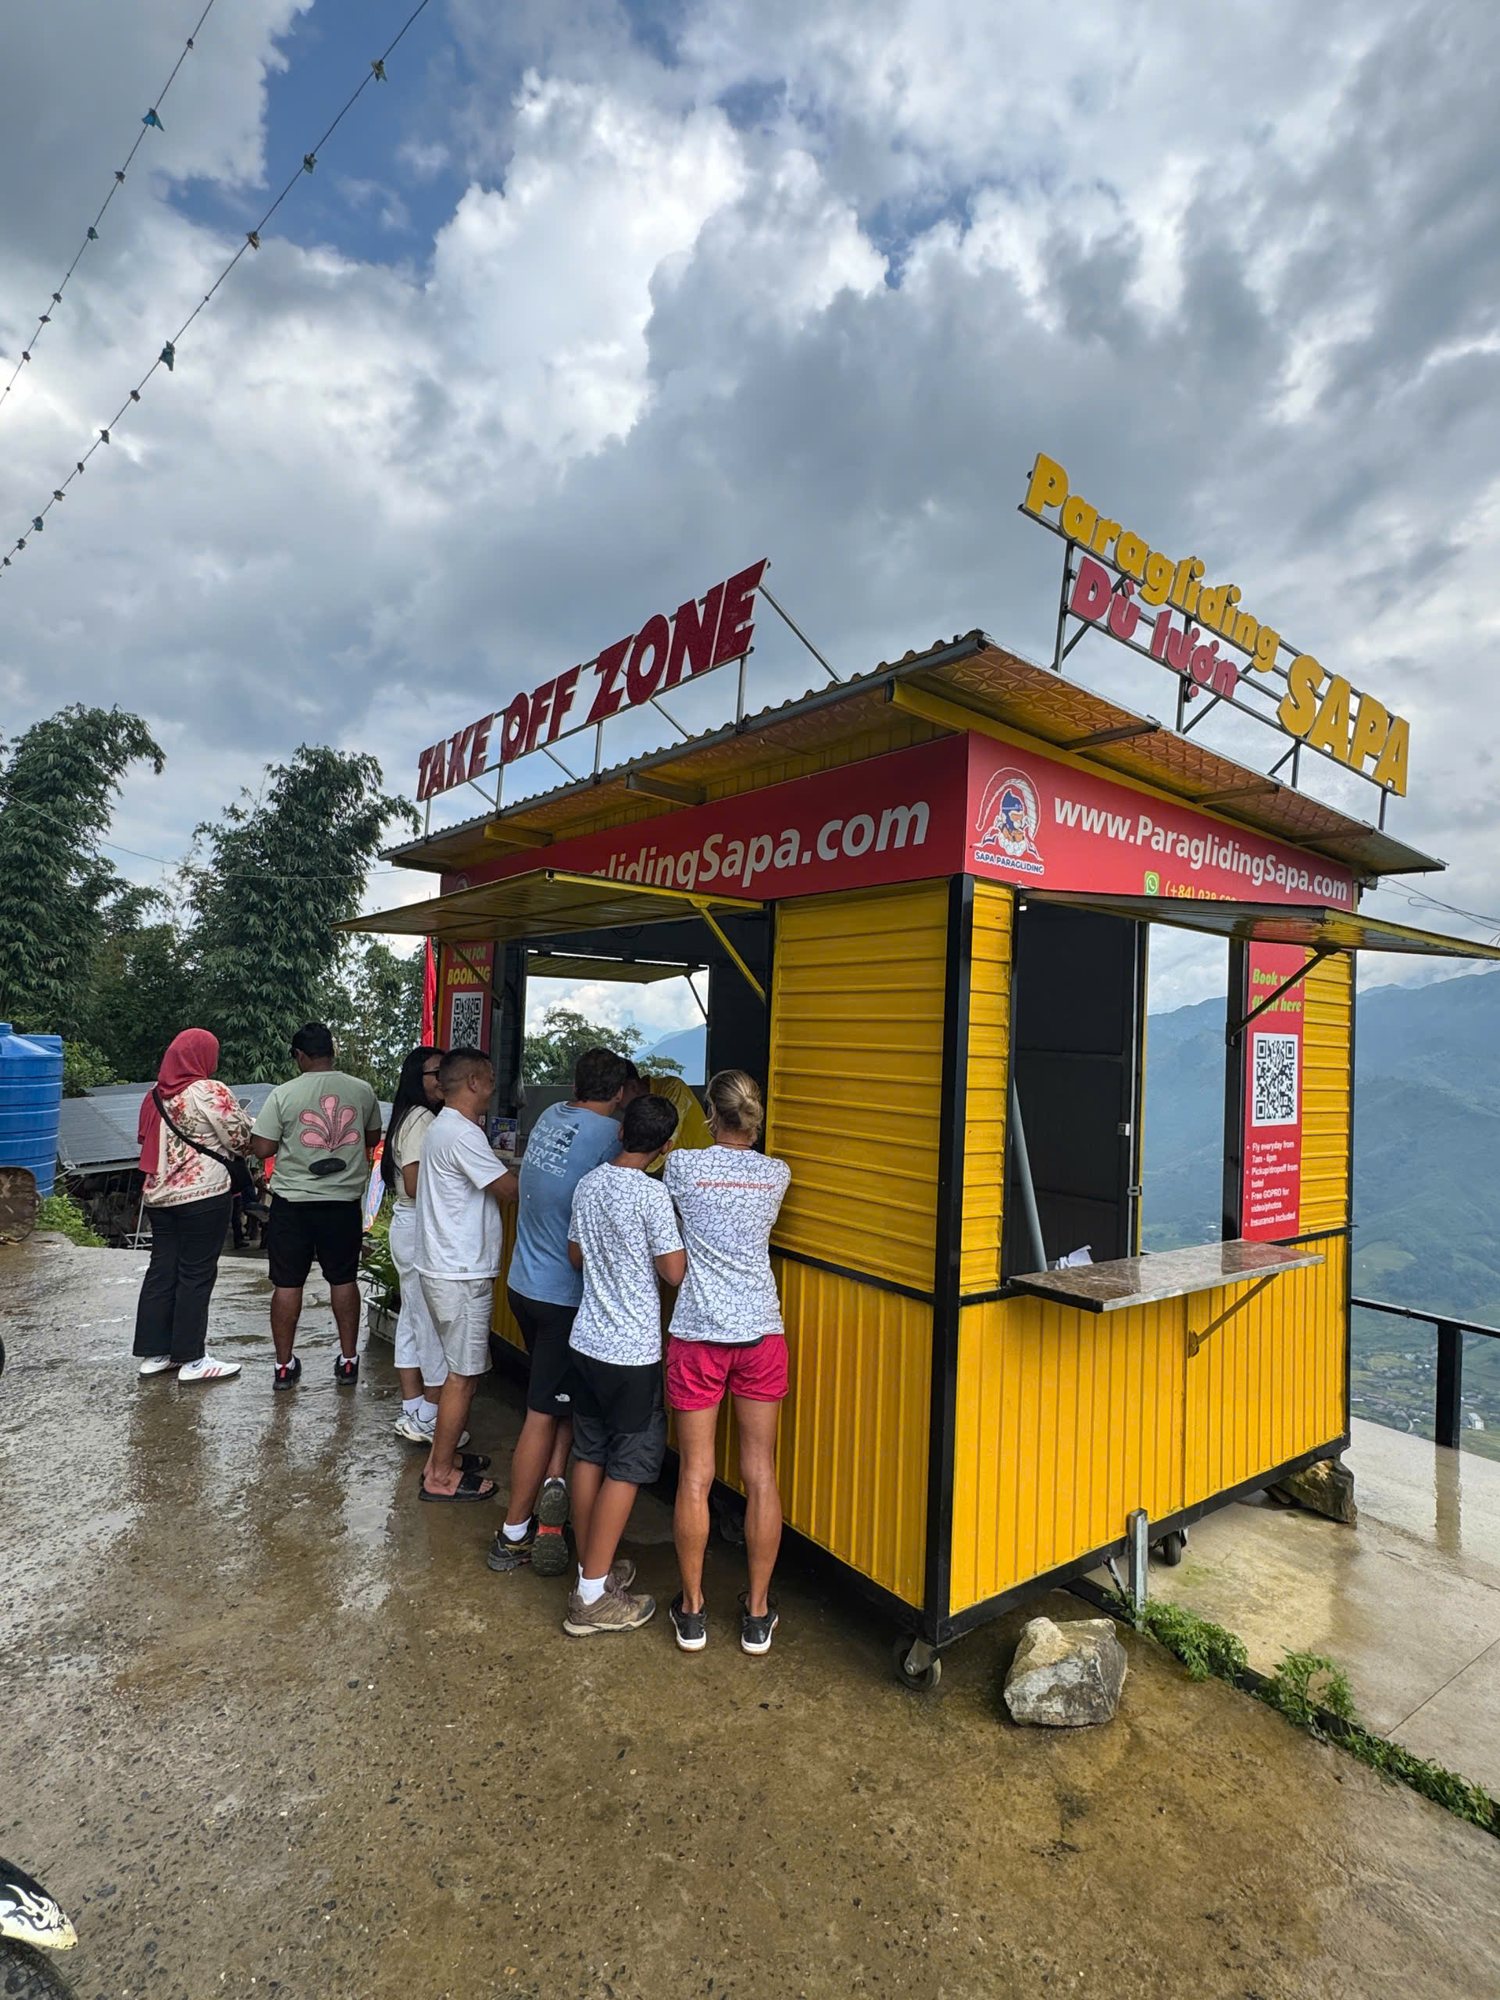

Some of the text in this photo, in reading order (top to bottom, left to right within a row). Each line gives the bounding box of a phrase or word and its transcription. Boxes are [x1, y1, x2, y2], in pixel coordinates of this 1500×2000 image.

[1025, 452, 1411, 798] Paragliding SAPA
[1067, 555, 1239, 699] Dù lượn
[416, 557, 768, 801] TAKE OFF ZONE
[590, 800, 931, 891] lidingSapa.com
[974, 850, 1045, 875] SAPA PARAGLIDING
[1053, 797, 1349, 901] www.ParaglidingSapa.com
[1252, 968, 1278, 986] Book
[1280, 997, 1302, 1013] here
[1250, 1215, 1275, 1227] Insurance
[1251, 1187, 1290, 1201] Free GOPRO for
